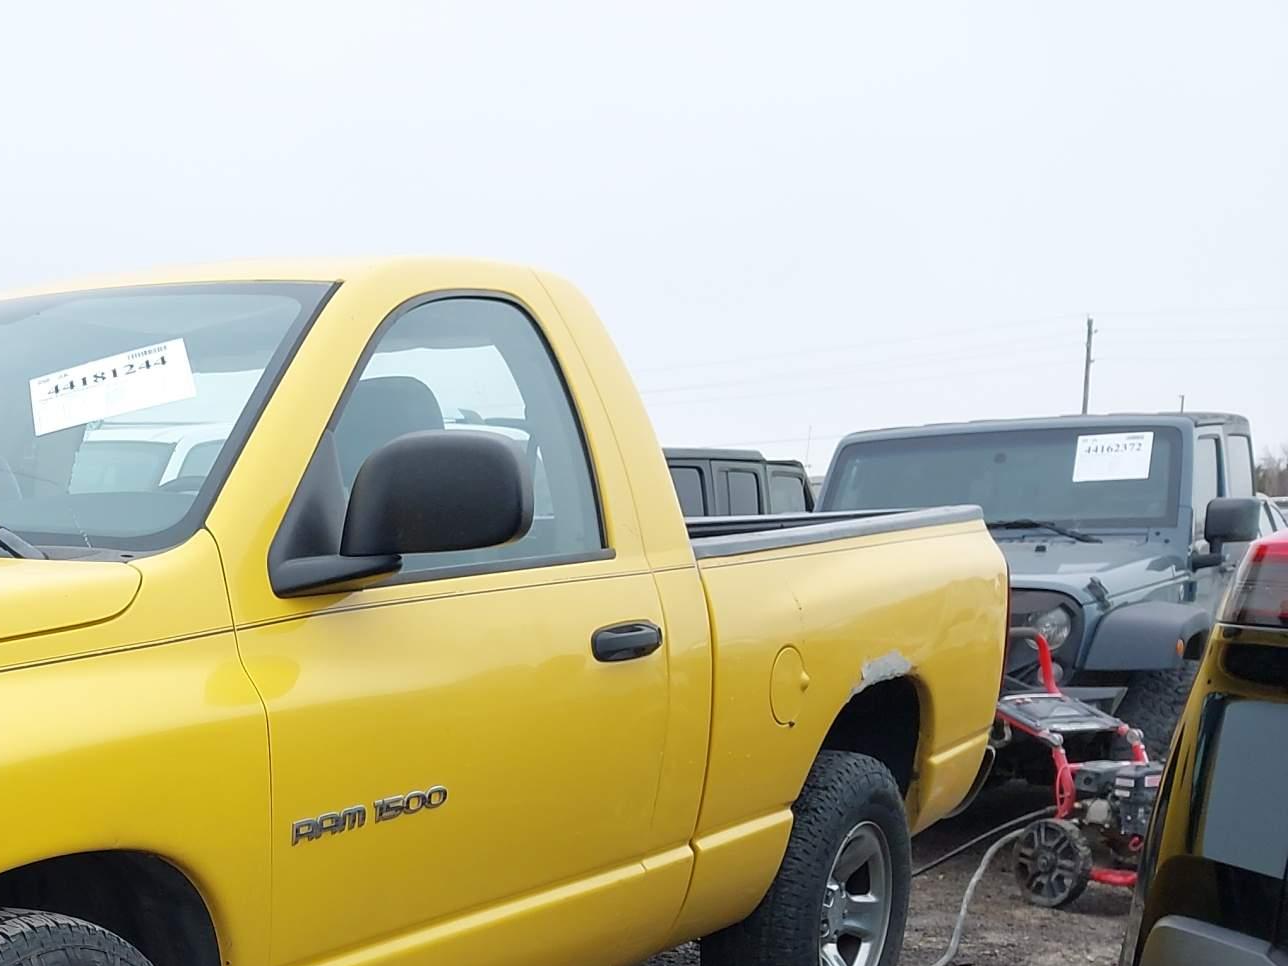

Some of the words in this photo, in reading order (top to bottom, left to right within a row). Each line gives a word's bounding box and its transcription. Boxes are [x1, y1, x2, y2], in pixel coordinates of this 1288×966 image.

[48, 356, 167, 394] 44181244
[1085, 443, 1142, 454] 44162372
[291, 804, 367, 846] RAM
[373, 785, 448, 824] 1500
